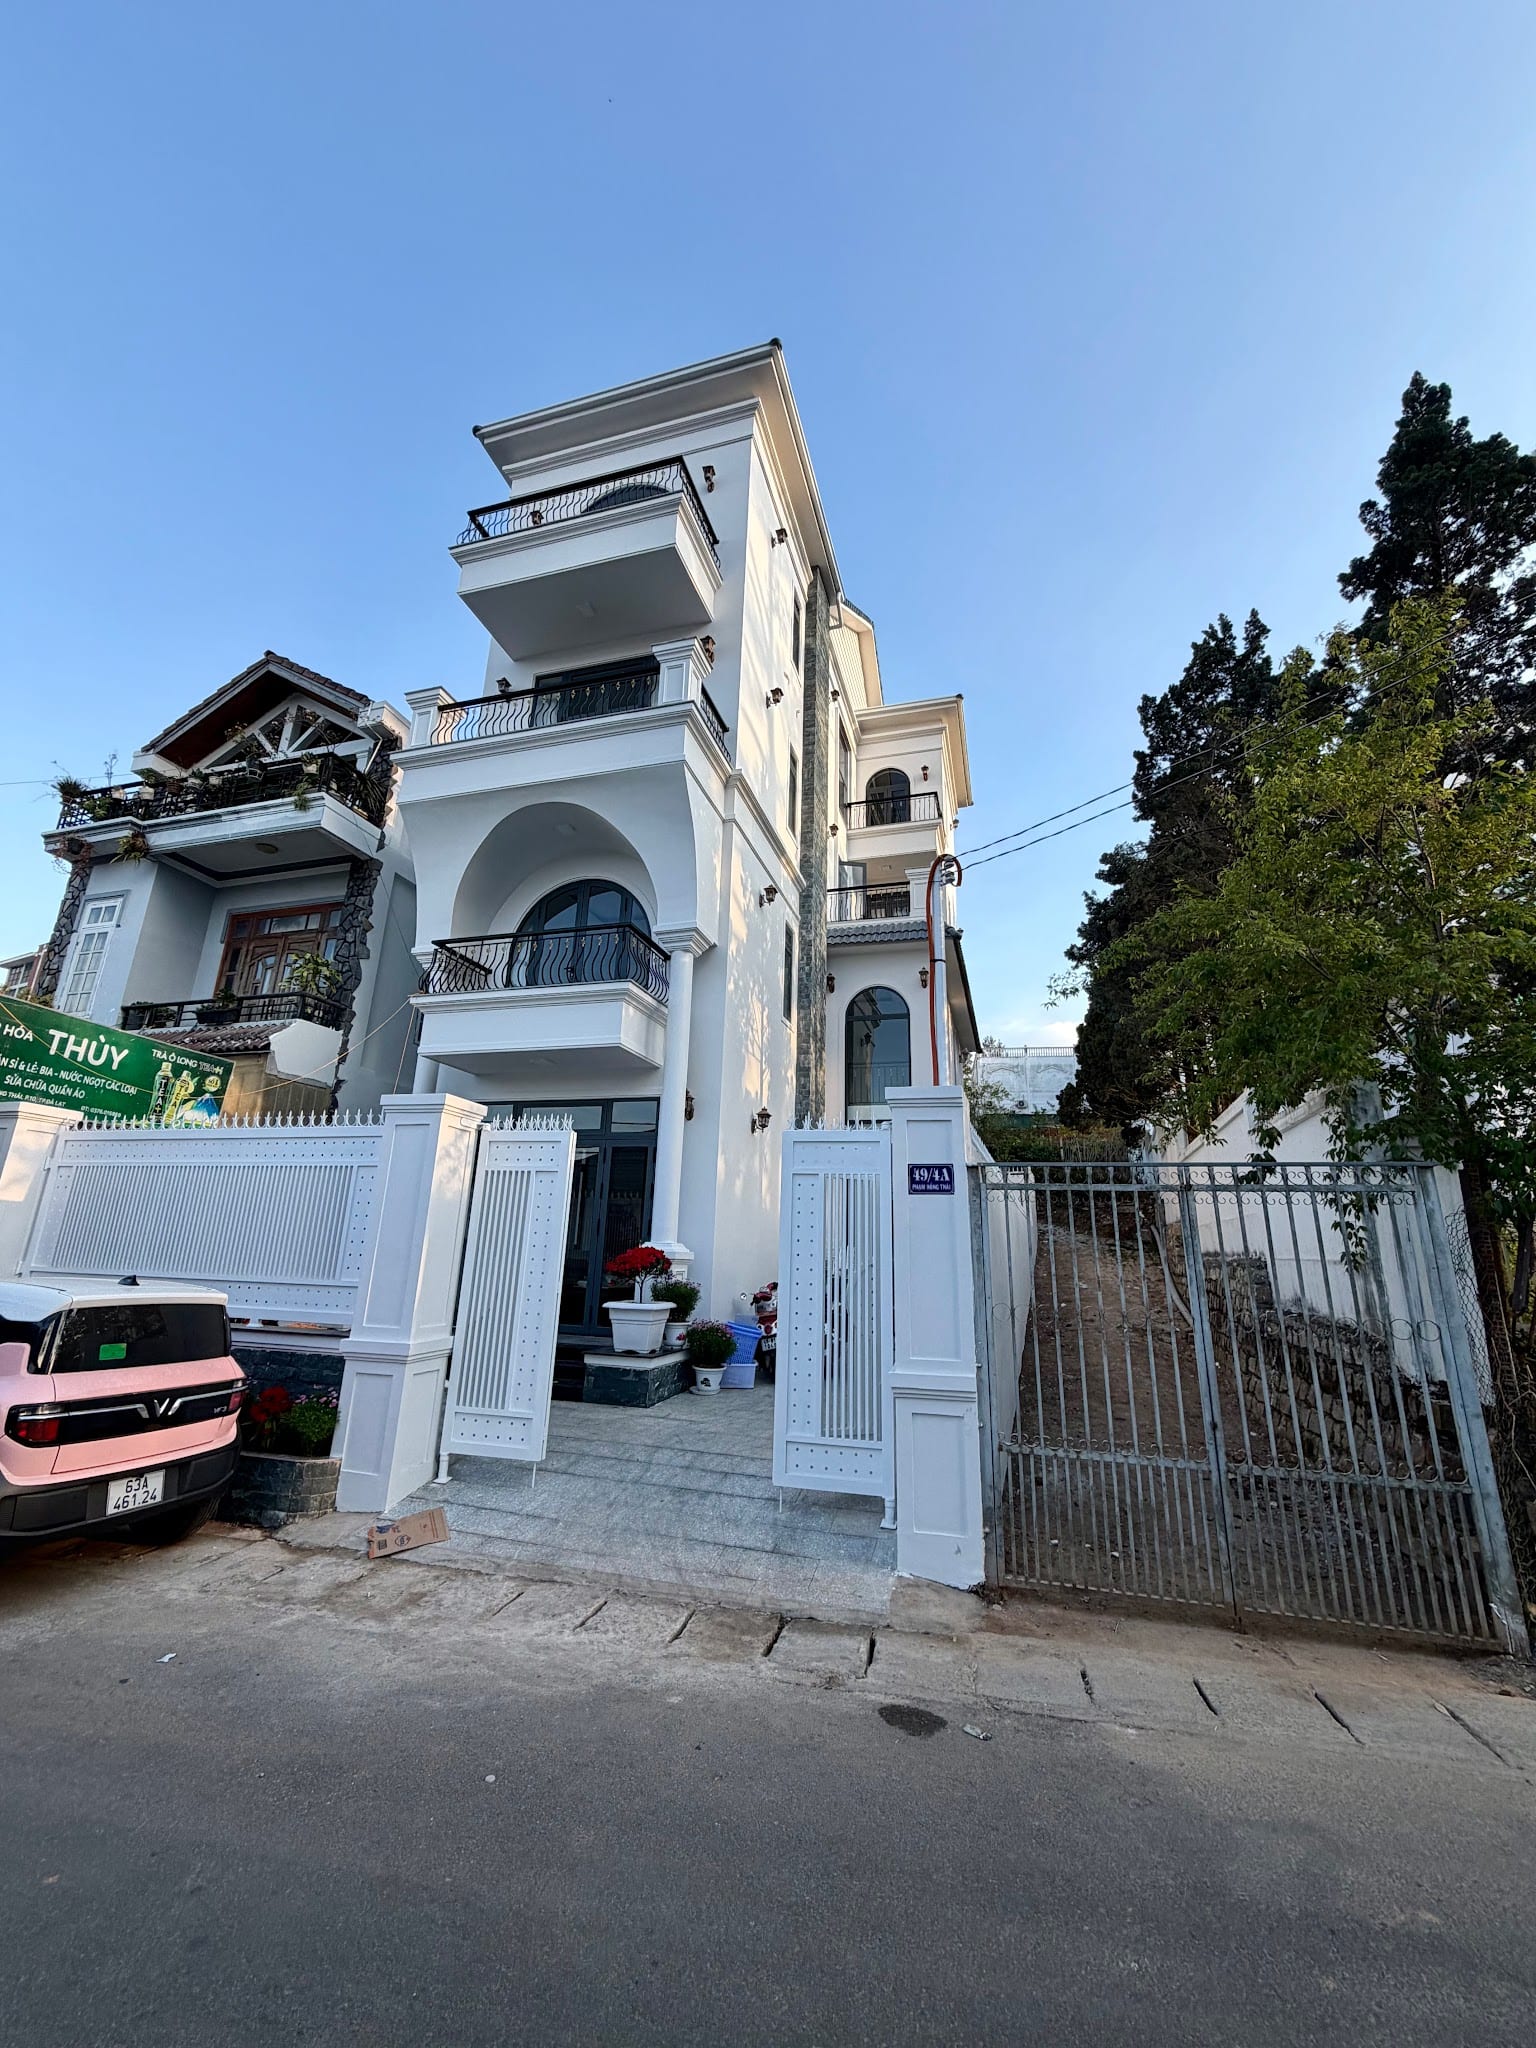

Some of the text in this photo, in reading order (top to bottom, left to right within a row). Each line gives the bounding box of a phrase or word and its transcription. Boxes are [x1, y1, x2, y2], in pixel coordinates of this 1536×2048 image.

[48, 1029, 129, 1070] THÙY
[152, 1049, 168, 1060] TRÀ
[177, 1056, 198, 1068] LONG
[18, 1061, 26, 1070] &
[39, 1066, 53, 1077] BIA
[912, 1167, 950, 1183] 49/4A
[125, 1477, 149, 1493] 63A
[113, 1487, 157, 1511] 461.24
